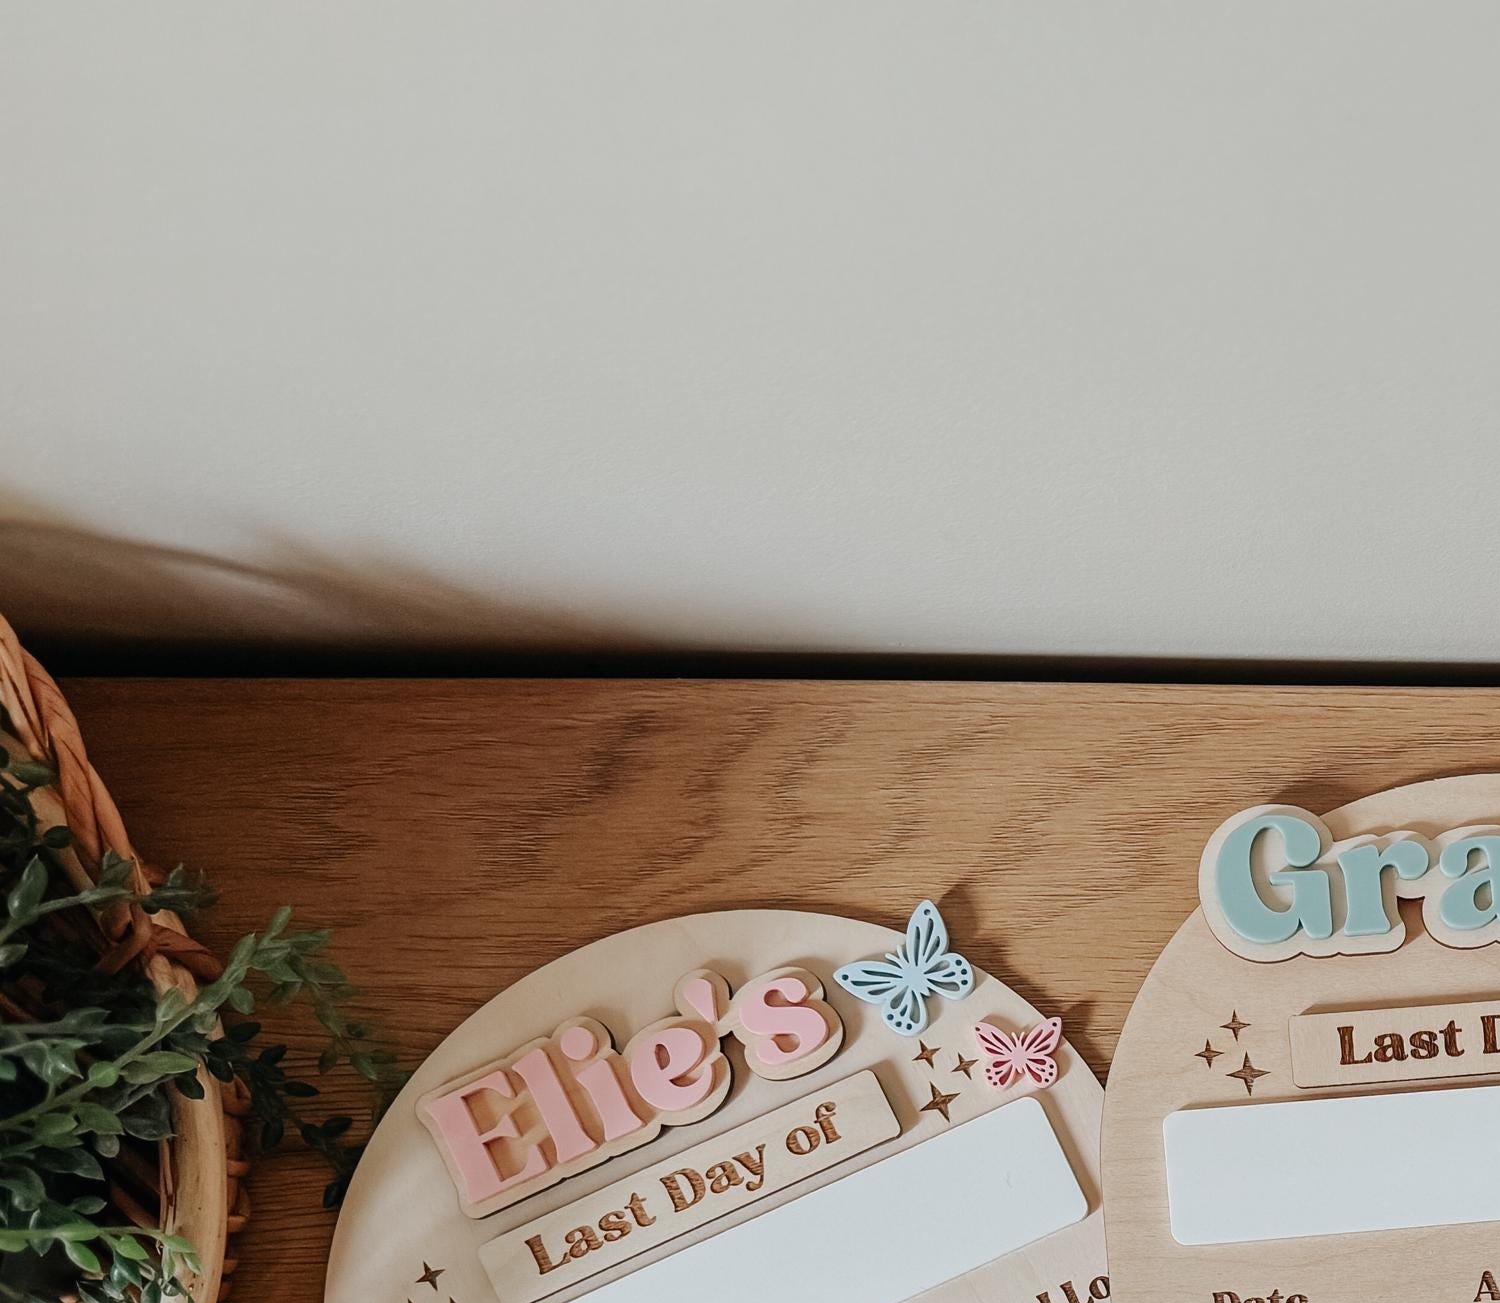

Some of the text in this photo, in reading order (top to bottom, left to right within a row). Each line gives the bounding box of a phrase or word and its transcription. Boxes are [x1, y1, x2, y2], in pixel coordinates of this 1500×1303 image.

[427, 976, 827, 1202] Elie's
[1338, 1019, 1464, 1066] Last
[523, 1102, 838, 1275] Last Day of
